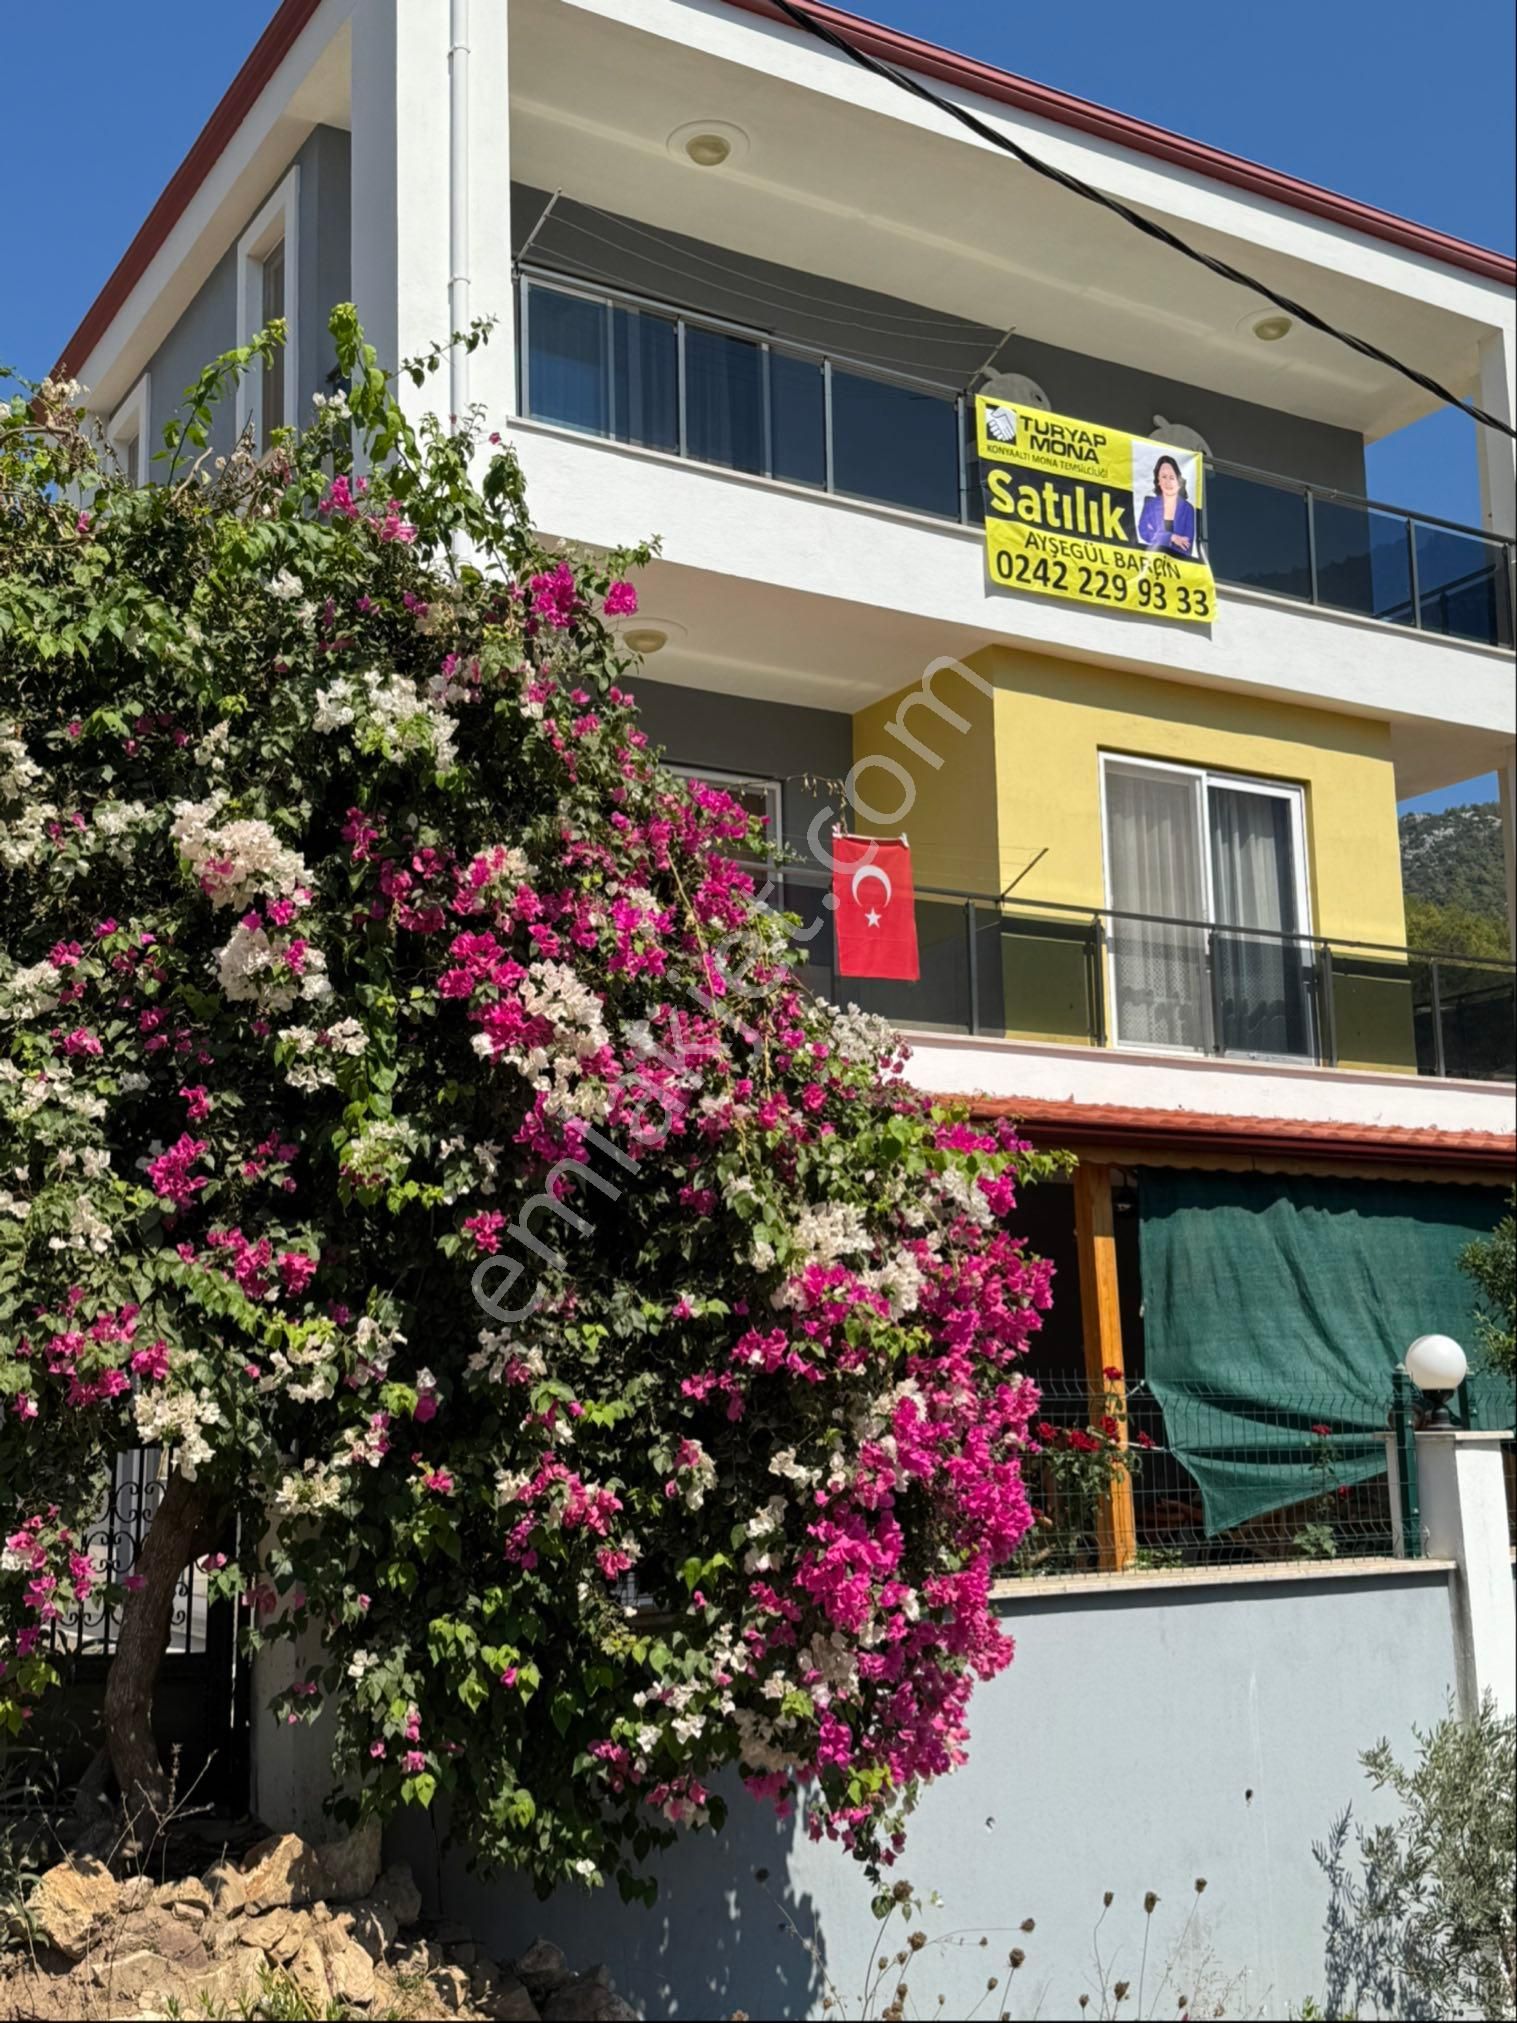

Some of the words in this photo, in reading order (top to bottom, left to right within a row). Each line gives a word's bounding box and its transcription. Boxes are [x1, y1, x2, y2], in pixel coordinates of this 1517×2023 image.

[1020, 415, 1107, 447] TURYAP
[987, 444, 1030, 460] KONYAALTI
[1032, 454, 1058, 467] MONA
[1030, 435, 1099, 464] MONA
[987, 469, 1129, 541] Satılık
[1025, 531, 1109, 566] AYŞEGÜL
[996, 550, 1069, 591] 0242
[1078, 566, 1127, 602] 229
[1138, 578, 1167, 610] 93
[1177, 586, 1209, 617] 33
